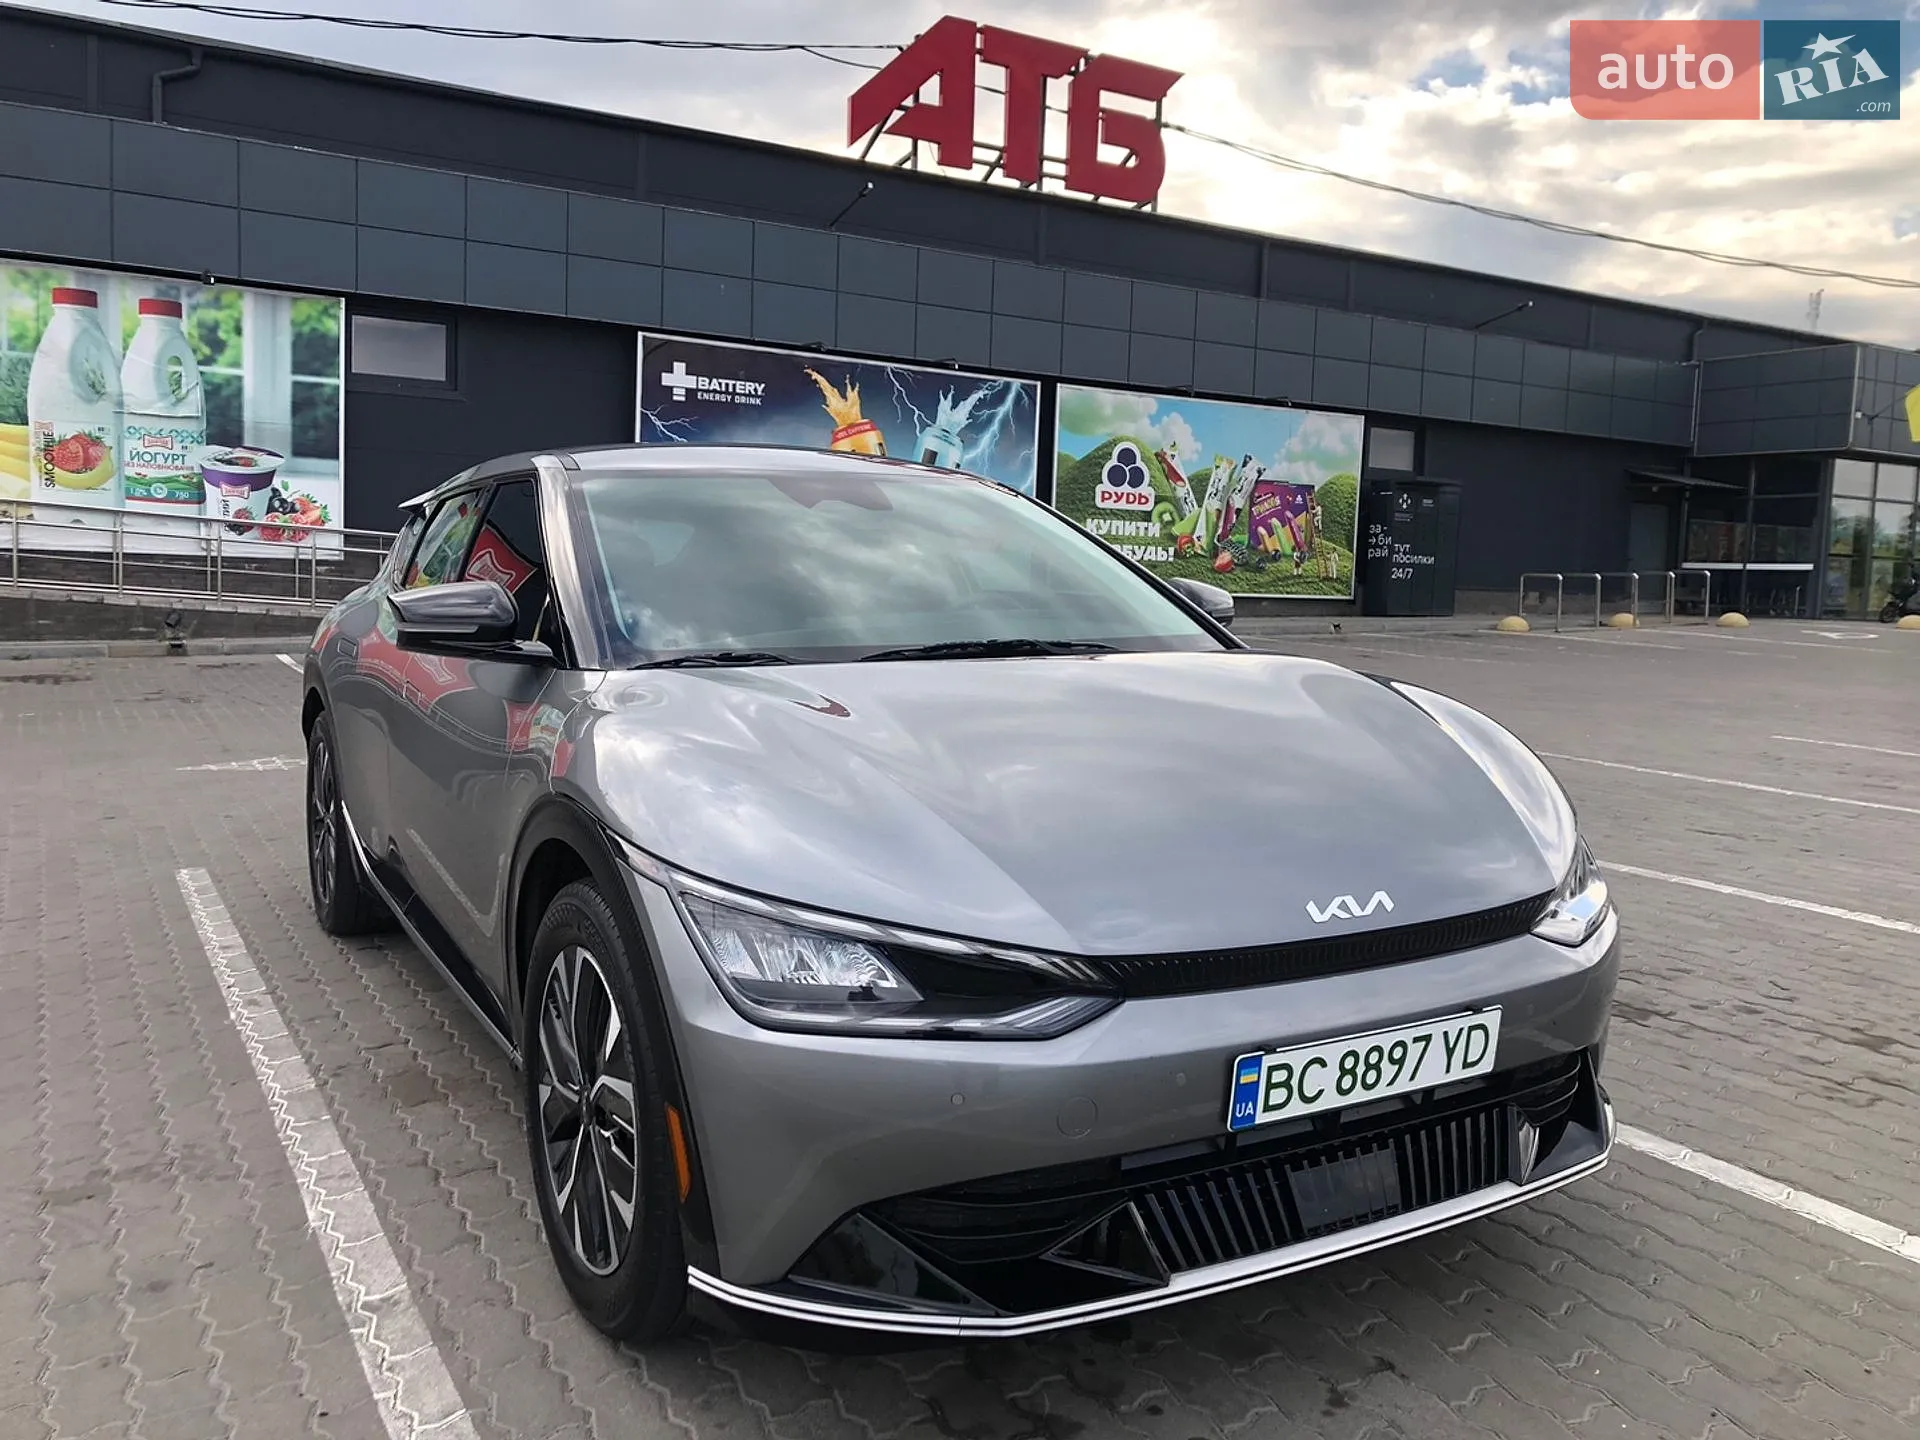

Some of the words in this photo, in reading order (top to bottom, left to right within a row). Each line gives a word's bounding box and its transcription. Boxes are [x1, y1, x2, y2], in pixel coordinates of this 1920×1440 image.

[847, 15, 1184, 203] АТБ
[698, 376, 766, 396] BATTERY
[697, 391, 732, 403] ENERGY
[735, 395, 762, 406] DRINK
[43, 431, 56, 488] SMOOTHIE
[129, 447, 187, 465] ЙОГУРТ
[1100, 490, 1150, 505] РУДЬ
[1086, 518, 1160, 537] КУПИТИ
[1378, 534, 1392, 545] би
[1368, 546, 1389, 559] рай
[1393, 544, 1411, 555] тут
[1392, 553, 1435, 565] посилки
[1391, 568, 1413, 579] 24/7
[1305, 890, 1395, 923] KIA
[1262, 1056, 1328, 1113] BC
[1335, 1033, 1433, 1097] 8897
[1442, 1022, 1490, 1074] YD
[1235, 1099, 1255, 1118] UA
